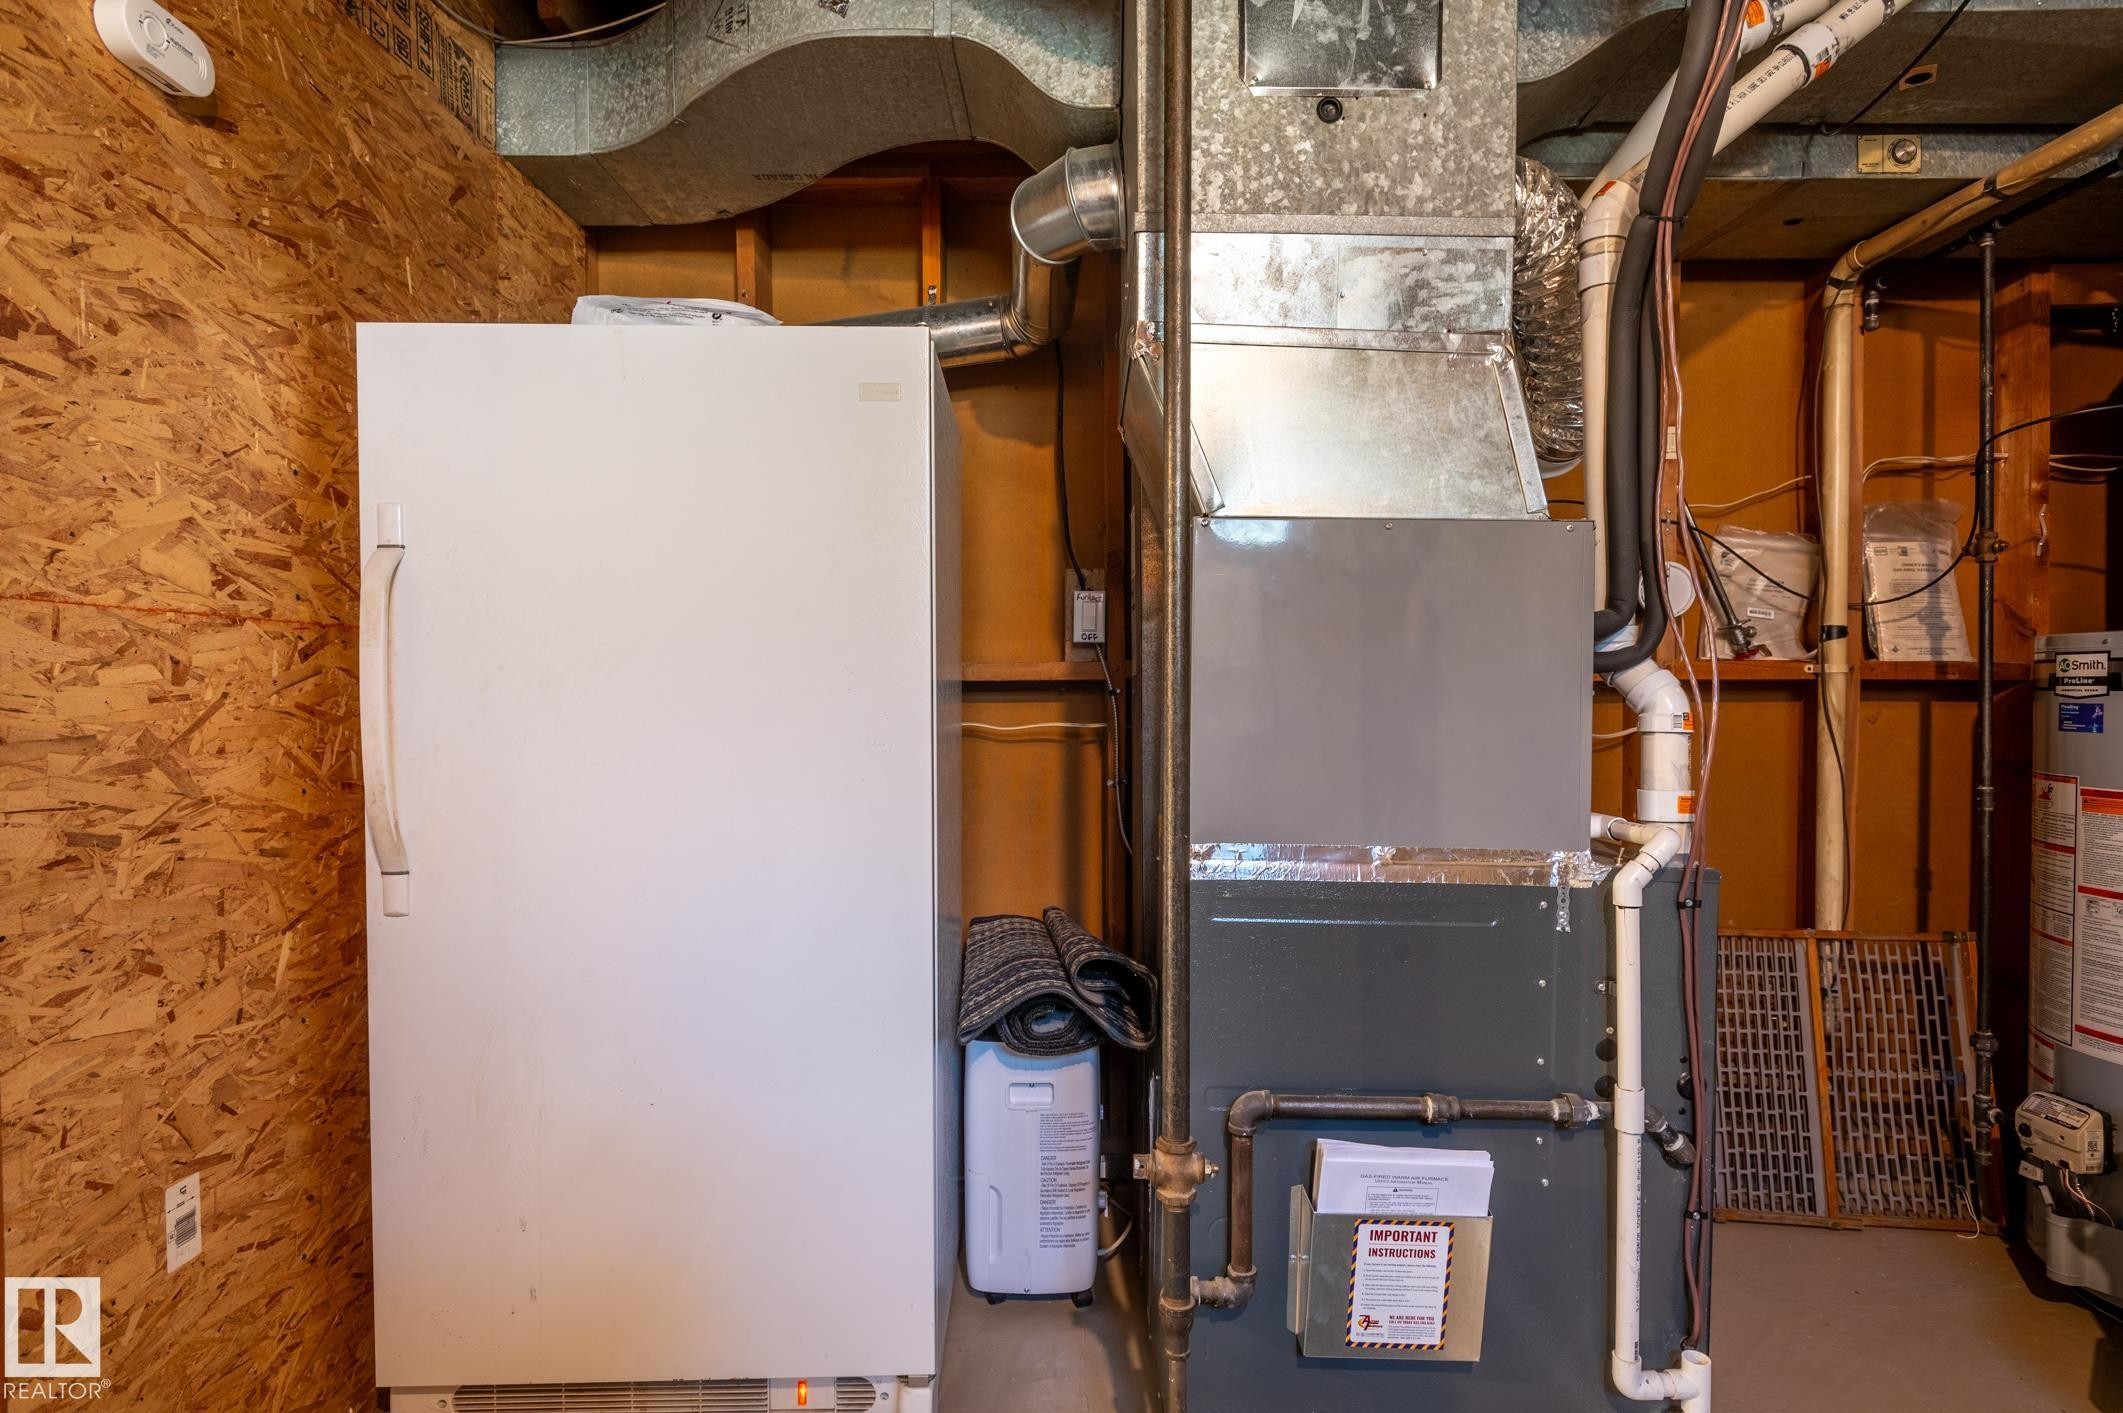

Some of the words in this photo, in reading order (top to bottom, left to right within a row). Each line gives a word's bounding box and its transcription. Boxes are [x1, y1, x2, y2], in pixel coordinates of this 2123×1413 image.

[1081, 633, 1098, 641] OFF
[1369, 1229, 1438, 1243] IMPORTANT
[1368, 1247, 1436, 1259] INSTRUCTIONS
